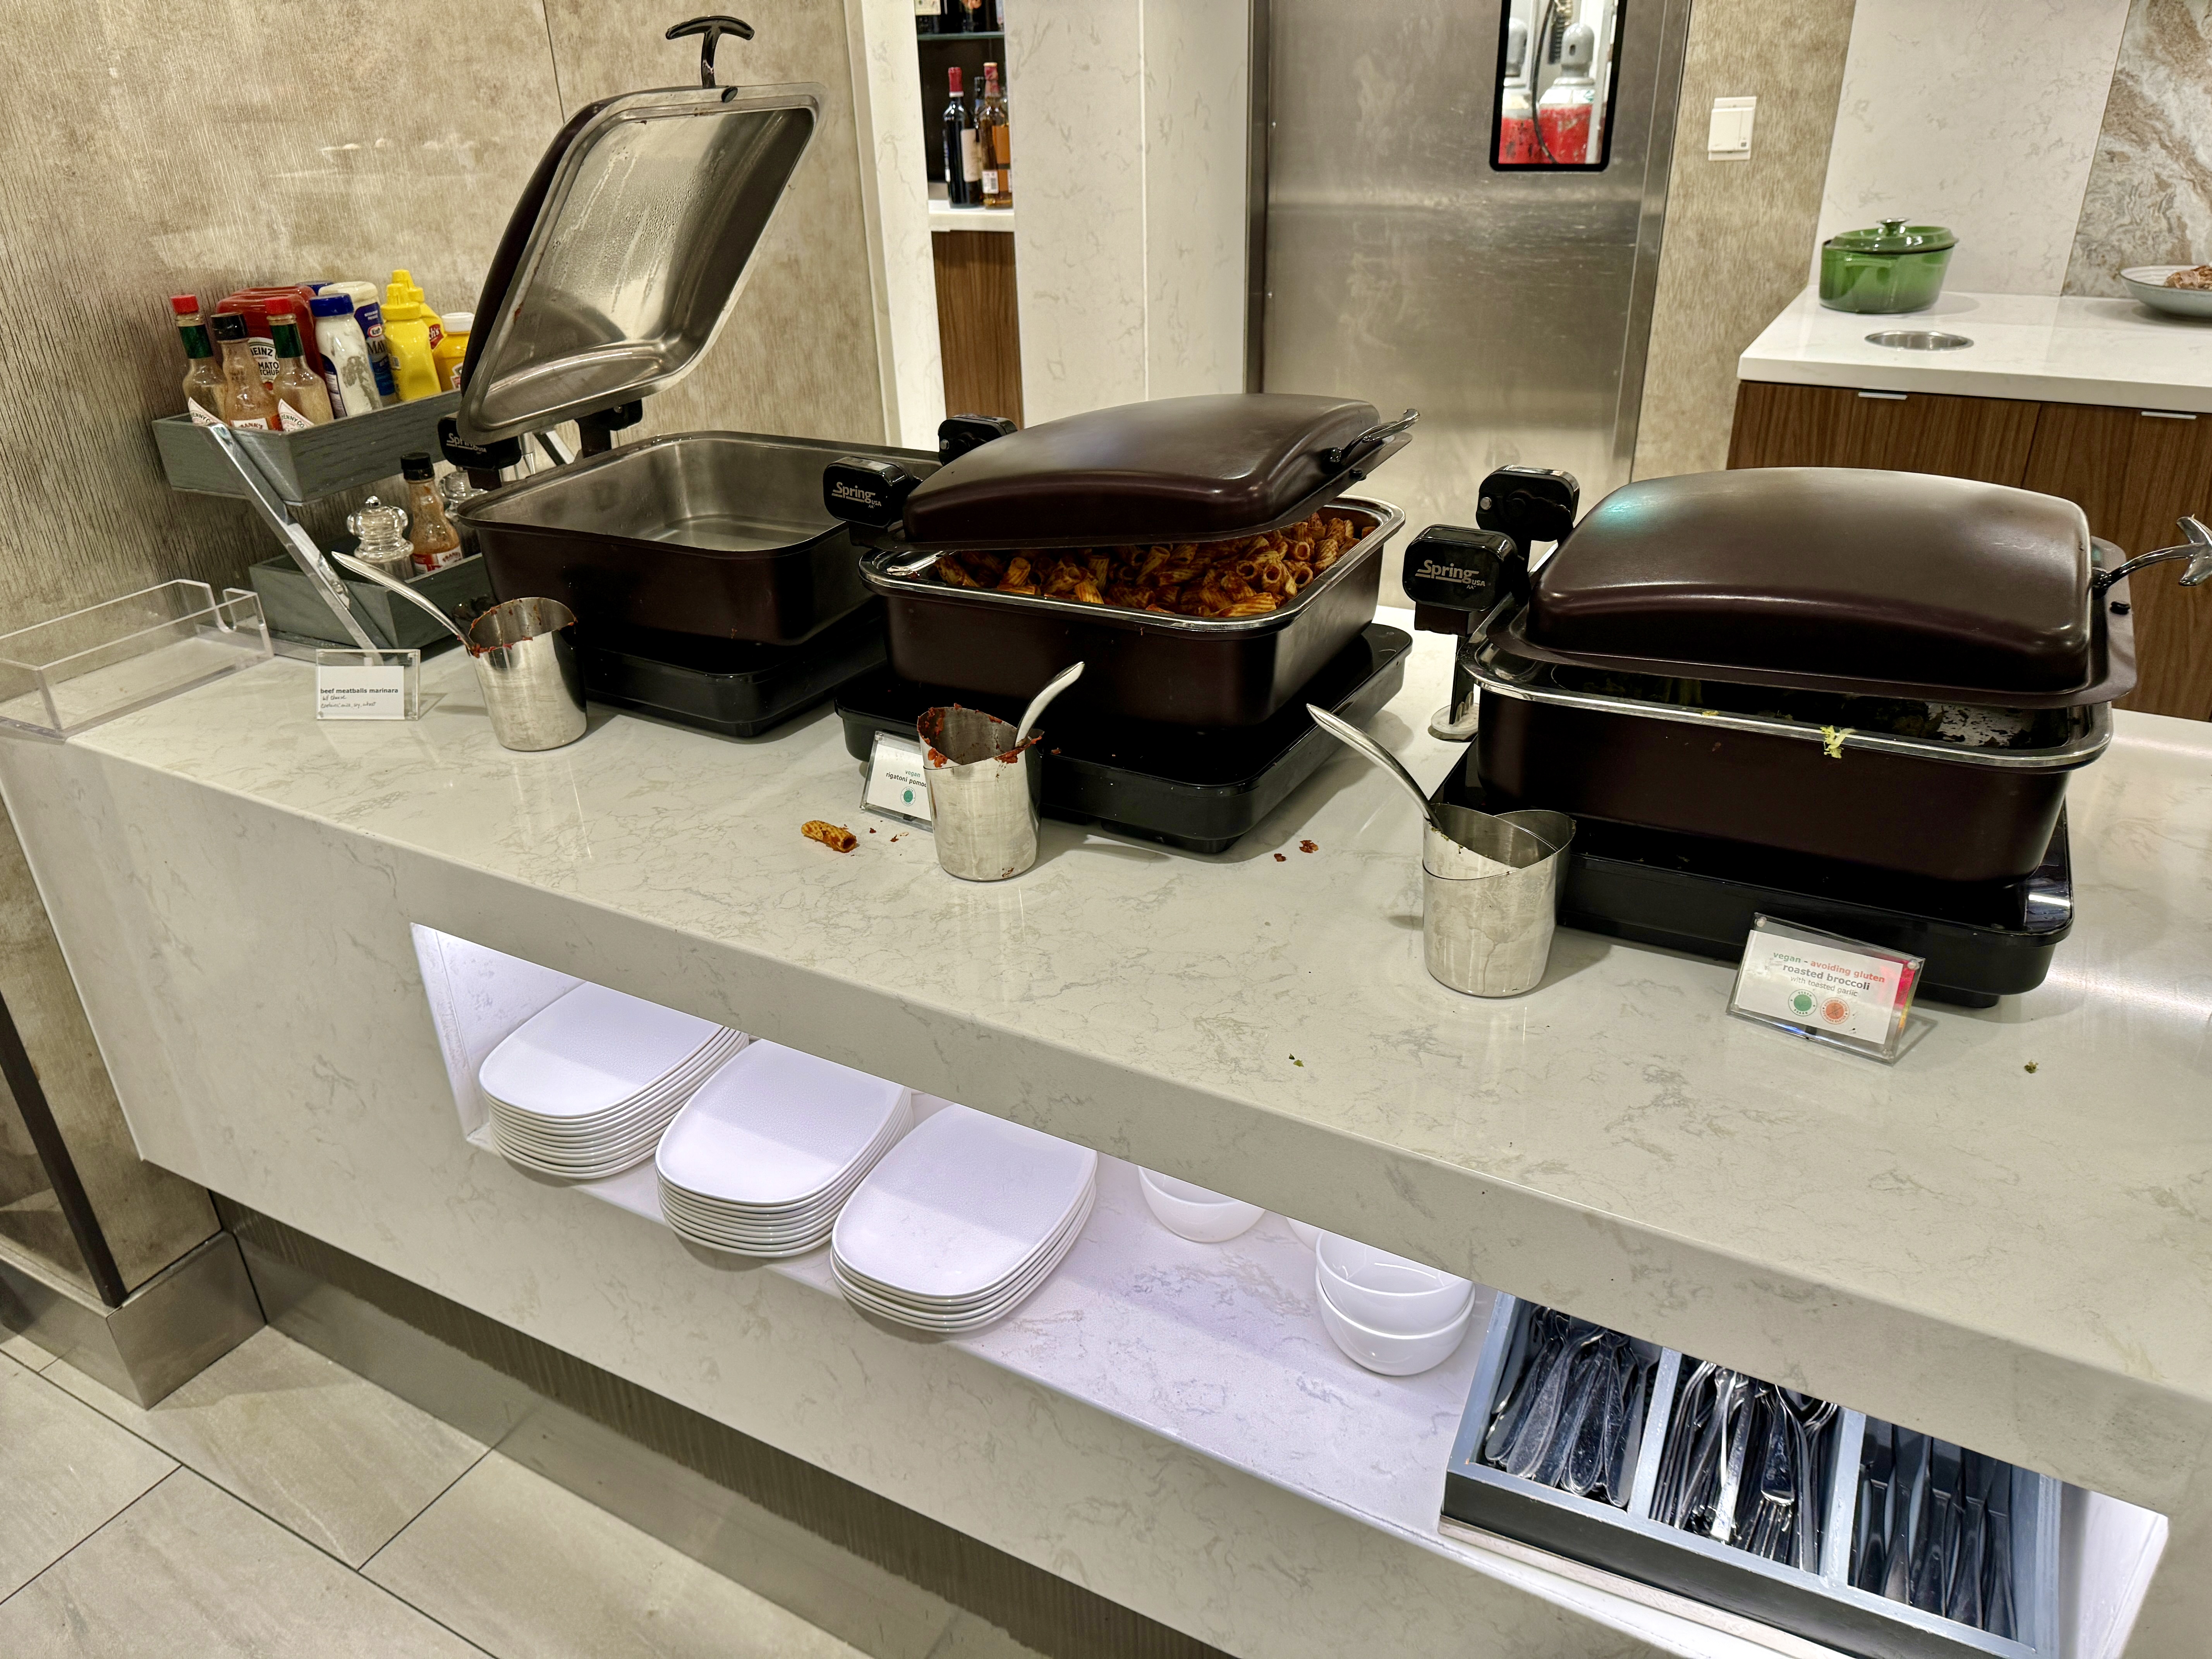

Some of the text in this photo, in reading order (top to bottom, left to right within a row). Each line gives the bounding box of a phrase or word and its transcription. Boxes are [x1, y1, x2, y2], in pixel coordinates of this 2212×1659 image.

[832, 481, 876, 504] Spring
[1417, 560, 1479, 584] Spring
[886, 772, 927, 787] rigatoni pomo
[1773, 952, 1801, 963] vegan
[1810, 960, 1851, 976] avoiding
[1854, 971, 1885, 983] gluten
[1783, 964, 1870, 990] roasted broccoli
[1790, 976, 1858, 996] with toasted garlic
